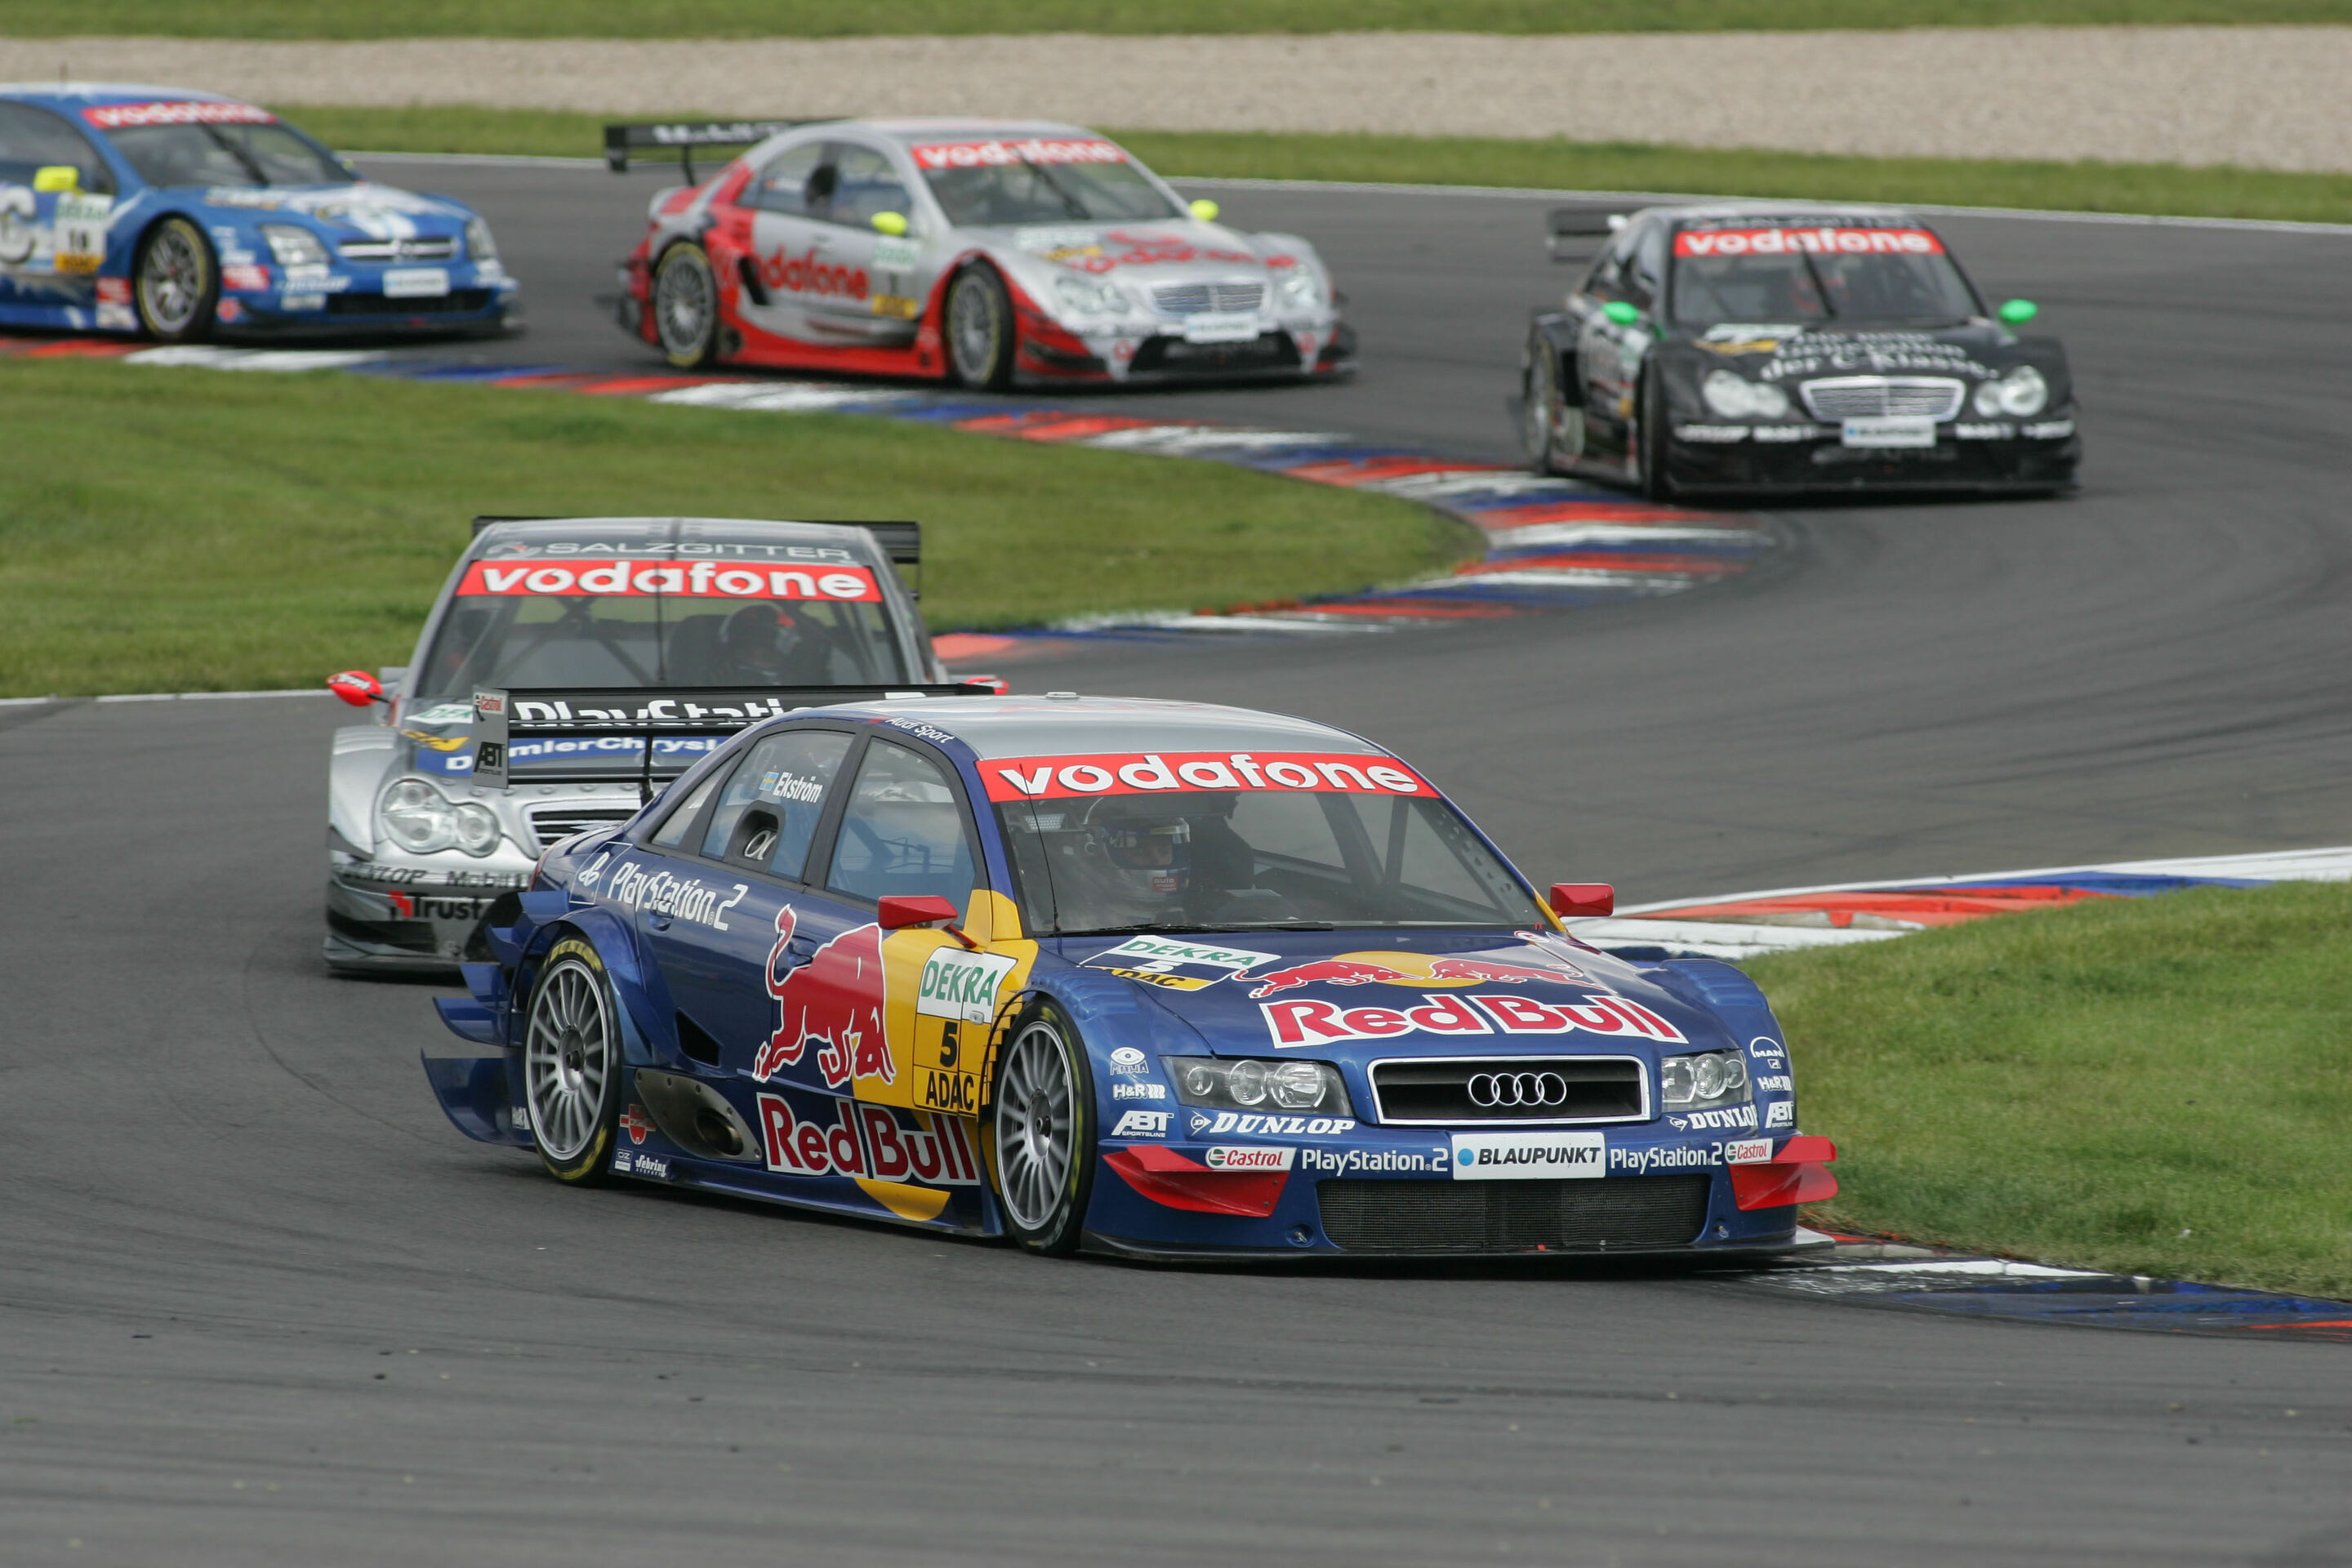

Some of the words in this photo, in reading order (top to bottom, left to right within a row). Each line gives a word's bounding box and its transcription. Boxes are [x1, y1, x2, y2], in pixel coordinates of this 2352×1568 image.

[1684, 228, 1932, 255] vodafone
[544, 541, 850, 561] SALZGITTER
[483, 562, 867, 599] vodafone
[884, 717, 924, 730] Audi
[915, 724, 955, 744] Sport
[473, 741, 503, 773] ABT
[773, 771, 823, 804] Ekström
[998, 755, 1419, 795] vodafone
[404, 892, 481, 920] Trust
[607, 862, 716, 924] PlayStation
[713, 883, 749, 932] 2
[1119, 940, 1258, 966] DEKRA
[1132, 960, 1183, 973] 5
[920, 960, 999, 1007] DEKRA
[1260, 994, 1494, 1048] Red
[1470, 994, 1687, 1043] Bull
[939, 1021, 958, 1068] 5
[925, 1071, 975, 1111] ADAC
[1113, 1084, 1147, 1100] H&R
[1111, 1110, 1168, 1136] ABT
[1209, 1113, 1356, 1134] DUNLOP
[1765, 1101, 1793, 1129] ABT
[757, 1093, 868, 1178] Red
[858, 1103, 979, 1184] Bull
[1737, 1143, 1767, 1160] Castrol
[617, 1151, 631, 1160] OZ
[1227, 1149, 1283, 1167] Castrol
[1302, 1149, 1425, 1177] PlayStation
[1432, 1147, 1449, 1172] 2
[1477, 1147, 1601, 1165] BLAUPUNKT
[1610, 1145, 1708, 1175] PlayStation
[1711, 1142, 1723, 1166] 2
